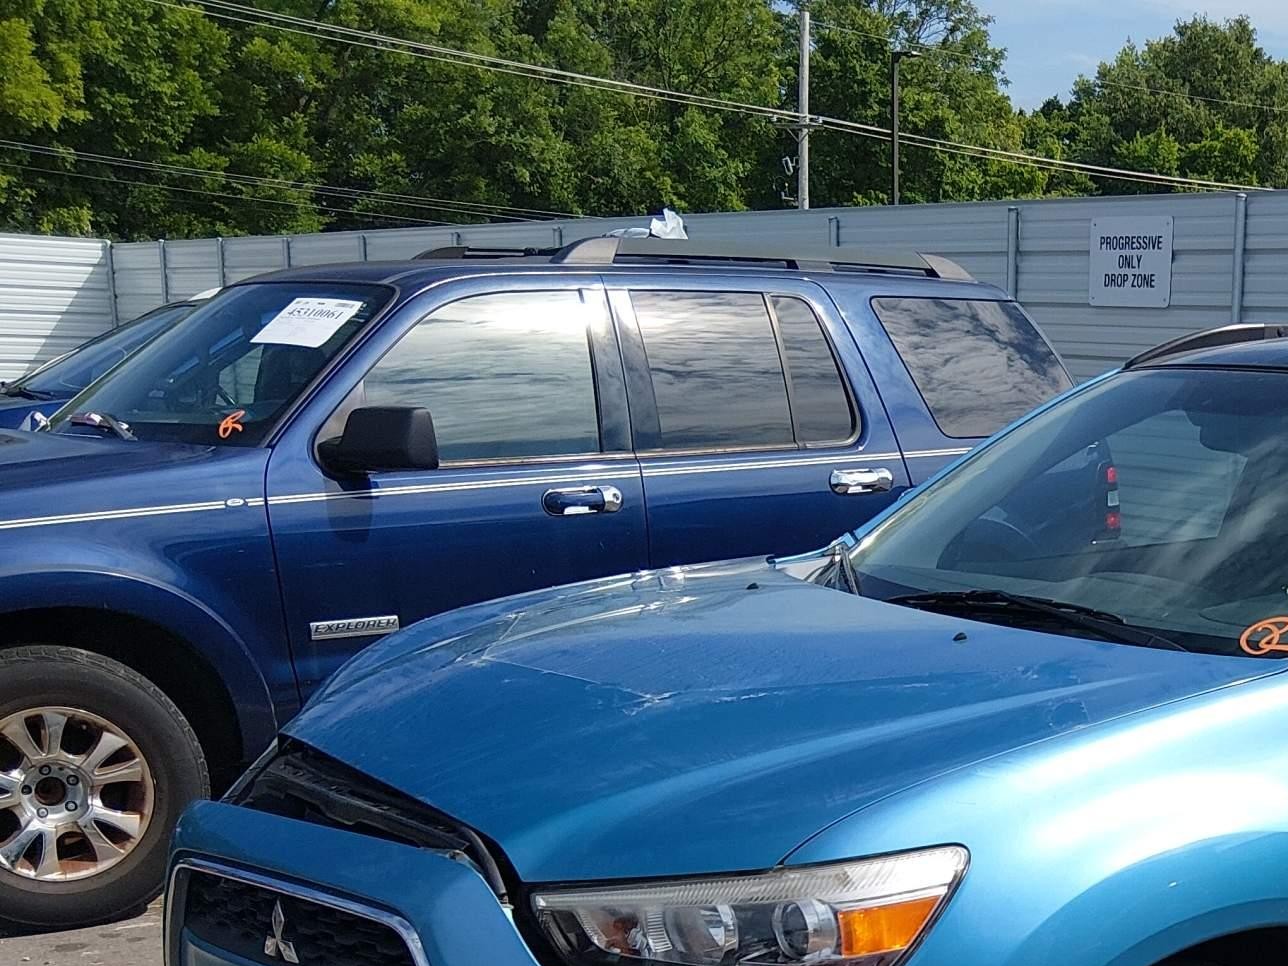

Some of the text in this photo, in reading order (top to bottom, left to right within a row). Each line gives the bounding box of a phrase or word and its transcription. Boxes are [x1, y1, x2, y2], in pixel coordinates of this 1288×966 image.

[1099, 235, 1163, 251] PROGRESSIVE
[1118, 254, 1143, 269] ONLY
[1103, 273, 1155, 288] DROP ZONE
[314, 618, 398, 633] EXPLORER
